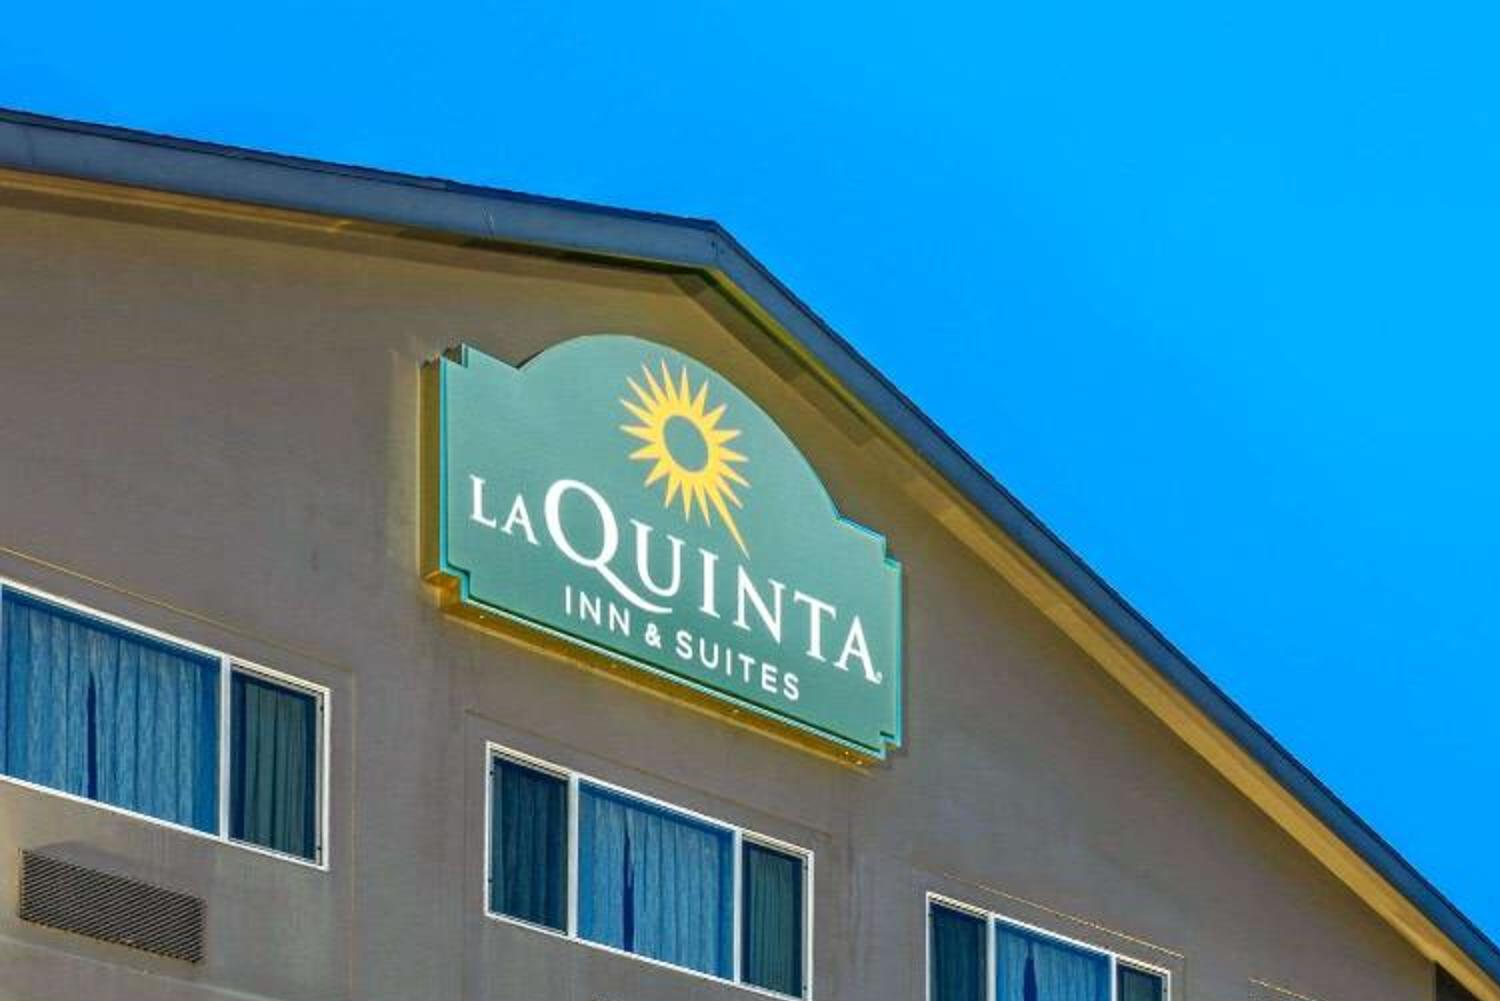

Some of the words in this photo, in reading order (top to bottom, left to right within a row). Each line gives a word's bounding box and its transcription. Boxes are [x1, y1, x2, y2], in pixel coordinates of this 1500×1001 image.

[468, 474, 539, 545] LA
[544, 478, 881, 684] QUINTA
[564, 584, 631, 637] INN
[644, 623, 662, 649] &
[675, 630, 799, 701] SUITES
